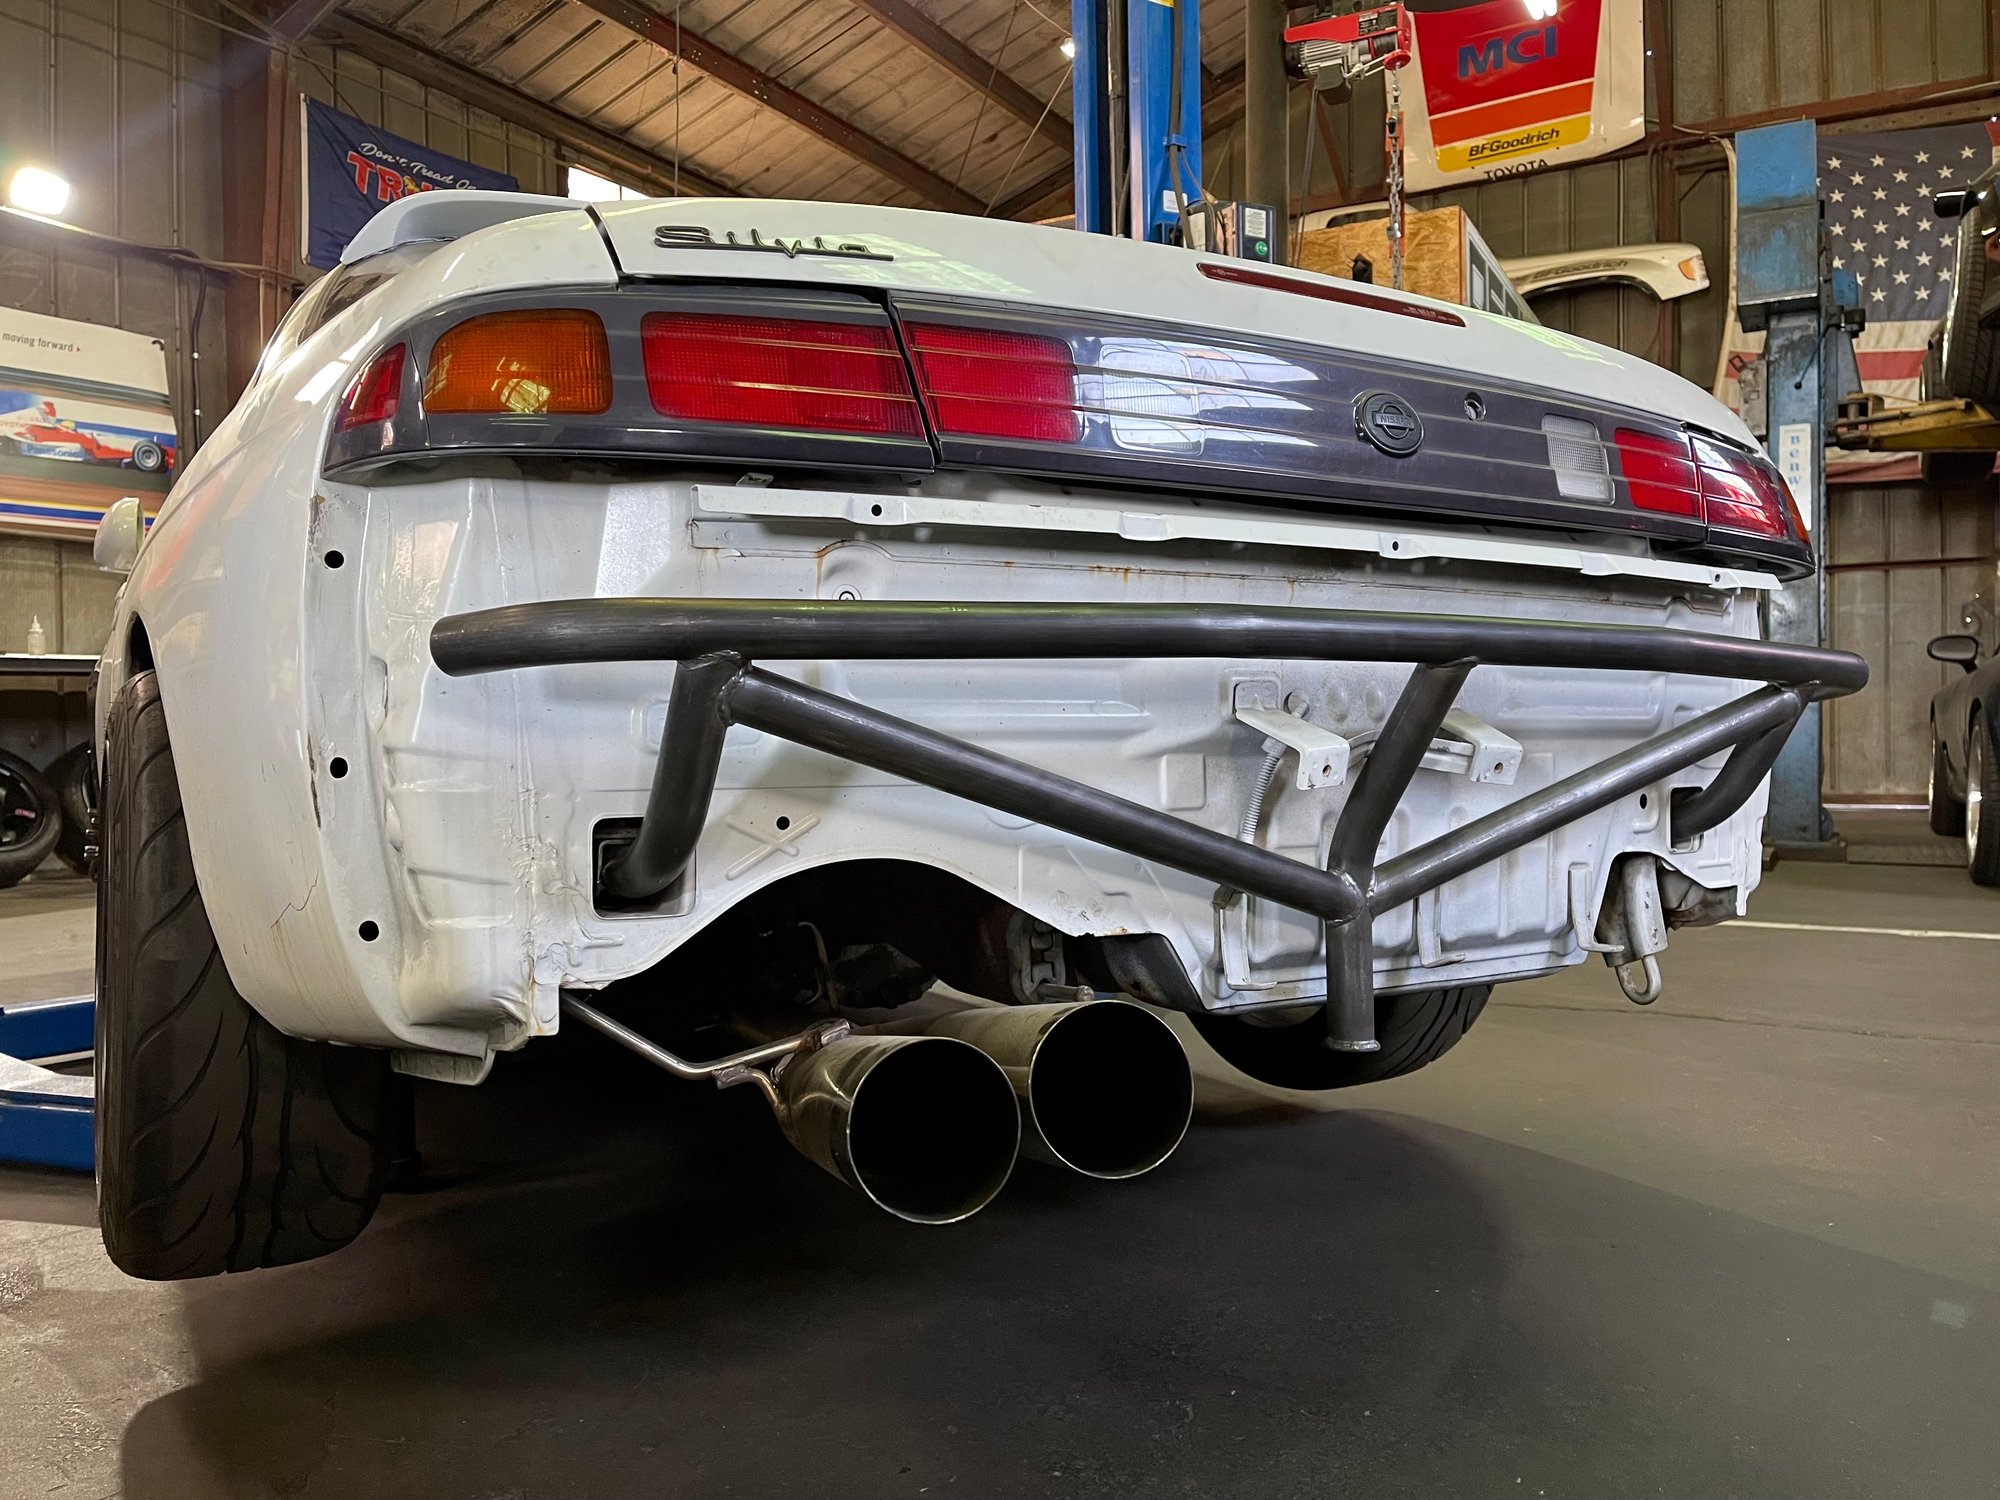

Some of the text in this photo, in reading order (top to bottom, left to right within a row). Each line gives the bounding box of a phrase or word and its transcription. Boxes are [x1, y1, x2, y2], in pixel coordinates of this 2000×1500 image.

[1458, 26, 1557, 78] MCI
[1469, 128, 1560, 157] BFGoodrich
[359, 142, 408, 167] Don't
[411, 162, 453, 184] Tread
[1483, 158, 1549, 180] TOYOTA
[654, 225, 894, 261] Silvia
[2, 332, 73, 352] moving forward
[1788, 435, 1801, 497] Benw
